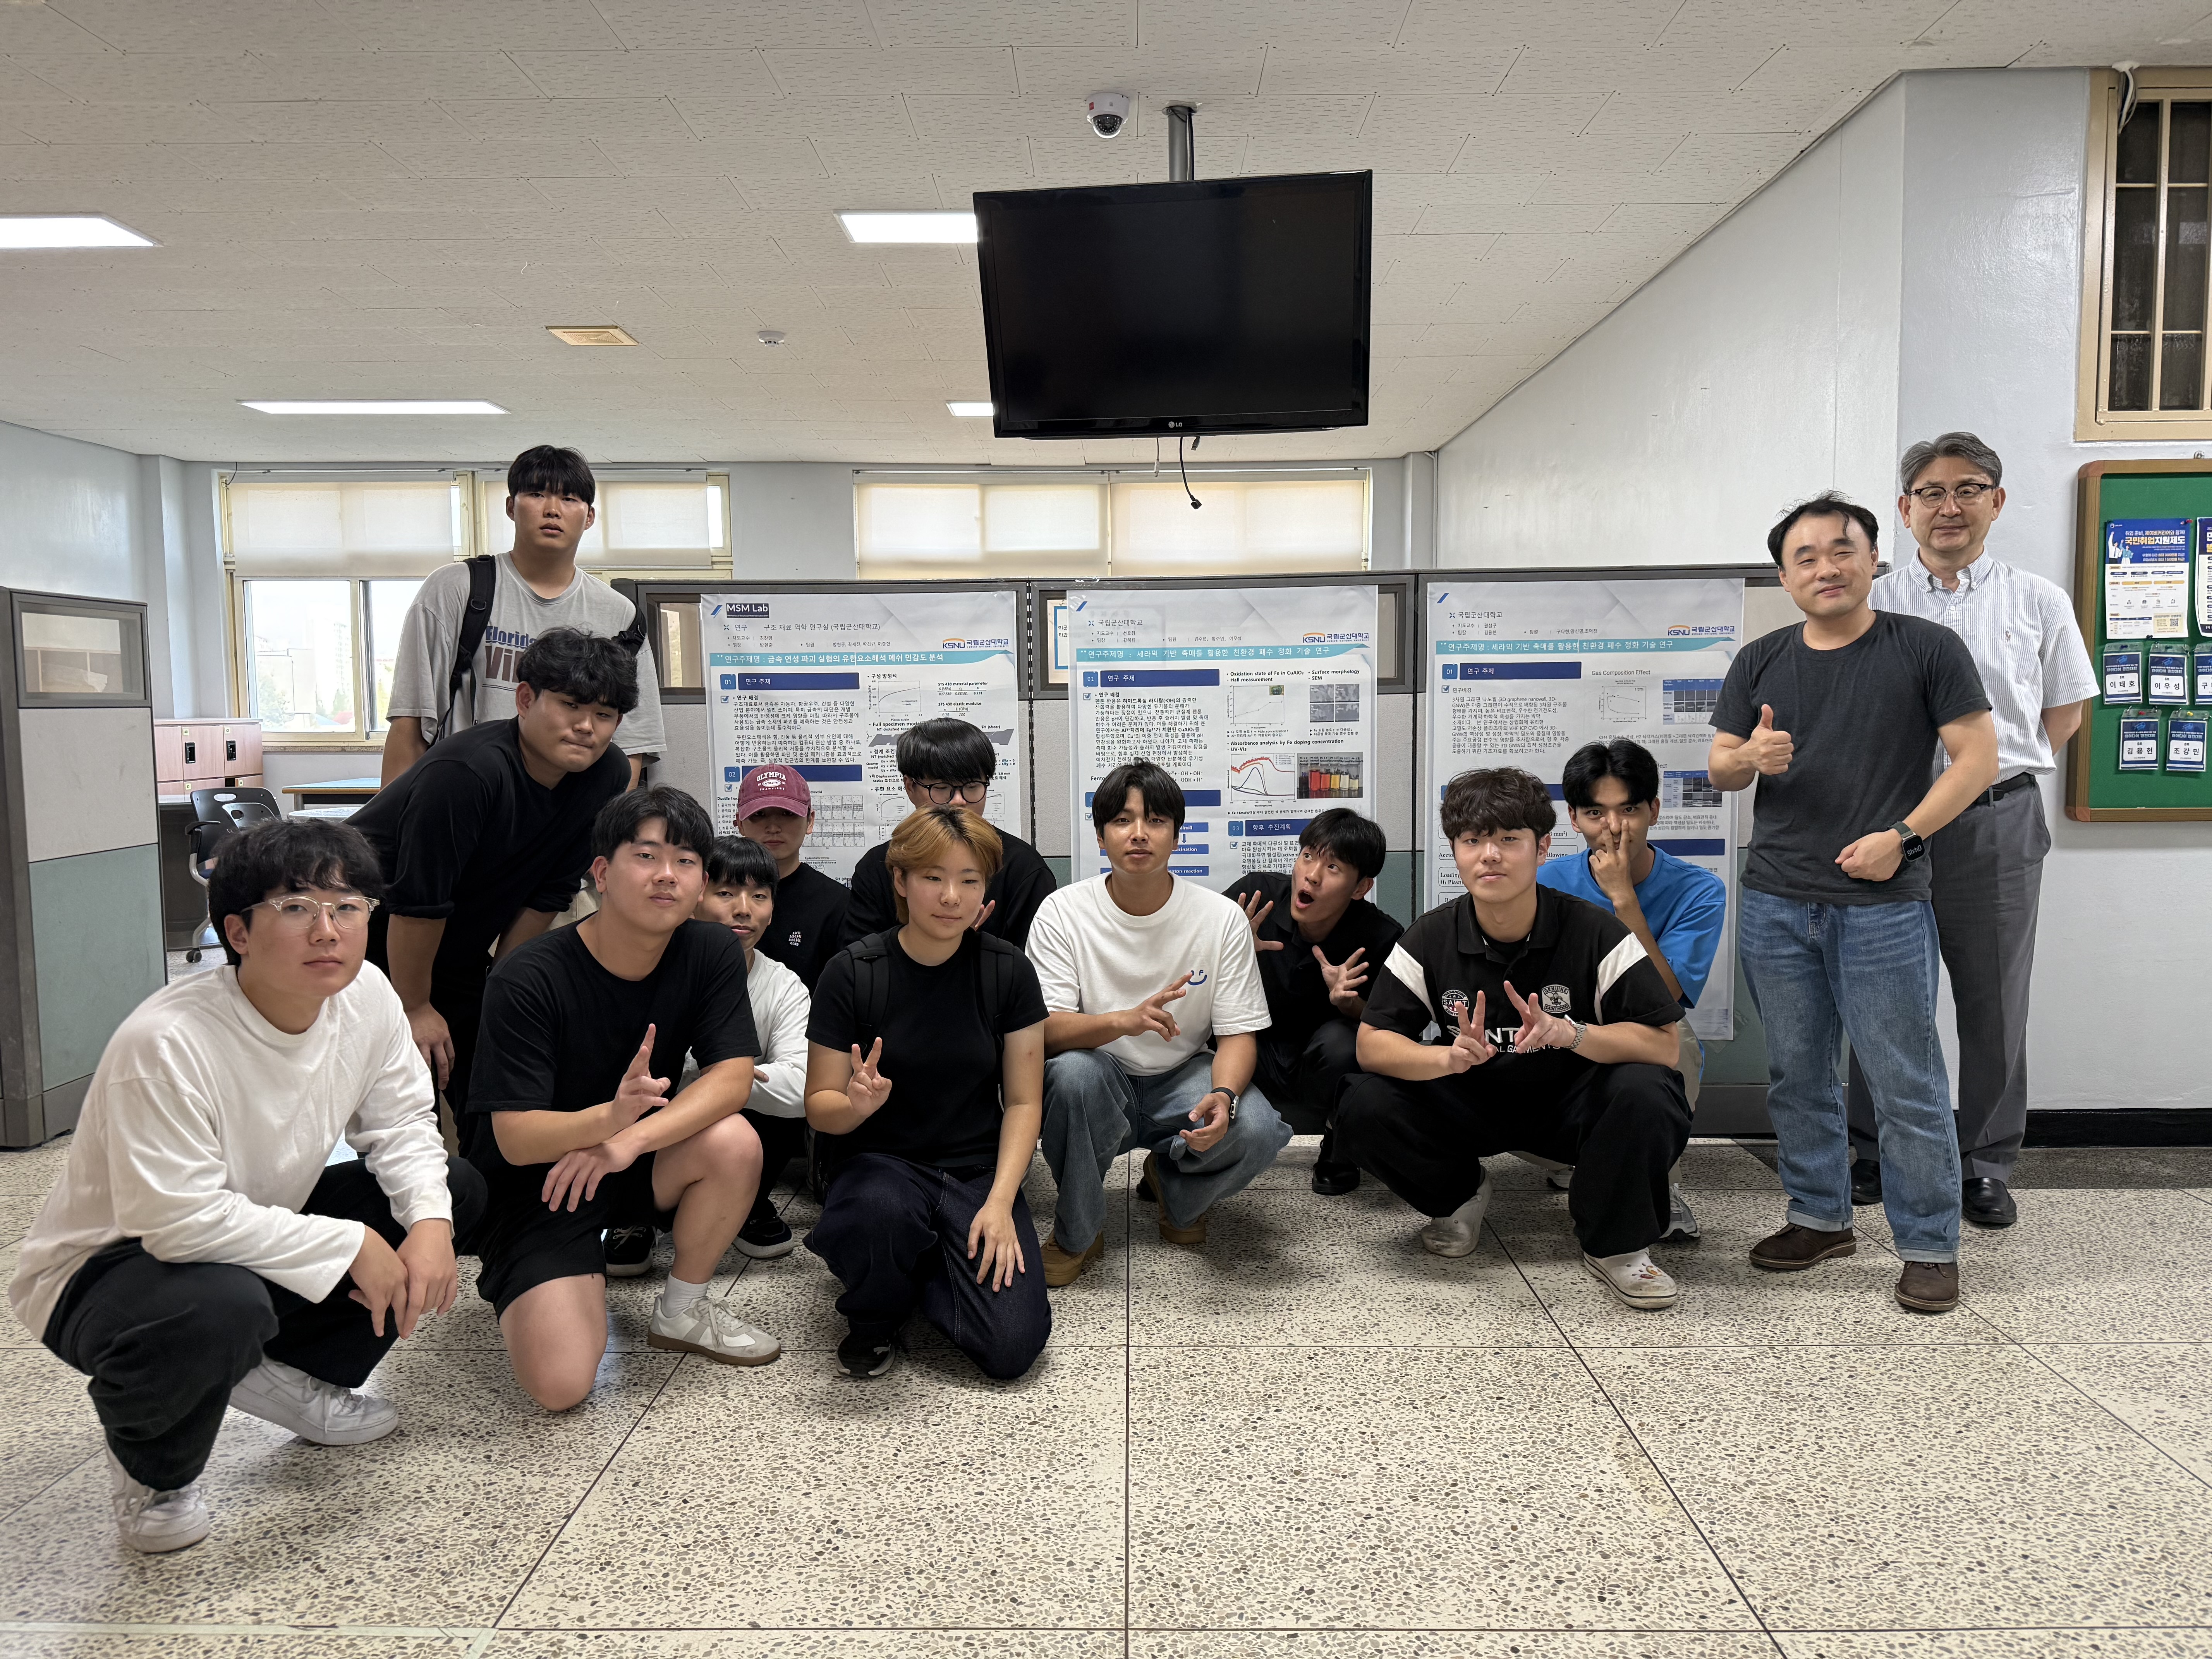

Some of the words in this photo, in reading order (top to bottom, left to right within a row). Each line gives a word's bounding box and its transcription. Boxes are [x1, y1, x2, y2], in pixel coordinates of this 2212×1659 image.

[2125, 536, 2185, 545] 국민취업지원제도
[726, 604, 749, 612] MSM
[752, 604, 768, 612] Lab
[1582, 642, 1604, 650] 친환경
[1659, 641, 1673, 649] 연구
[819, 655, 840, 663] 실험의
[842, 654, 886, 663] 유한요소해석
[929, 653, 943, 661] 분석
[1088, 650, 1123, 658] 연구주제명
[757, 772, 786, 782] OLYMPIA
